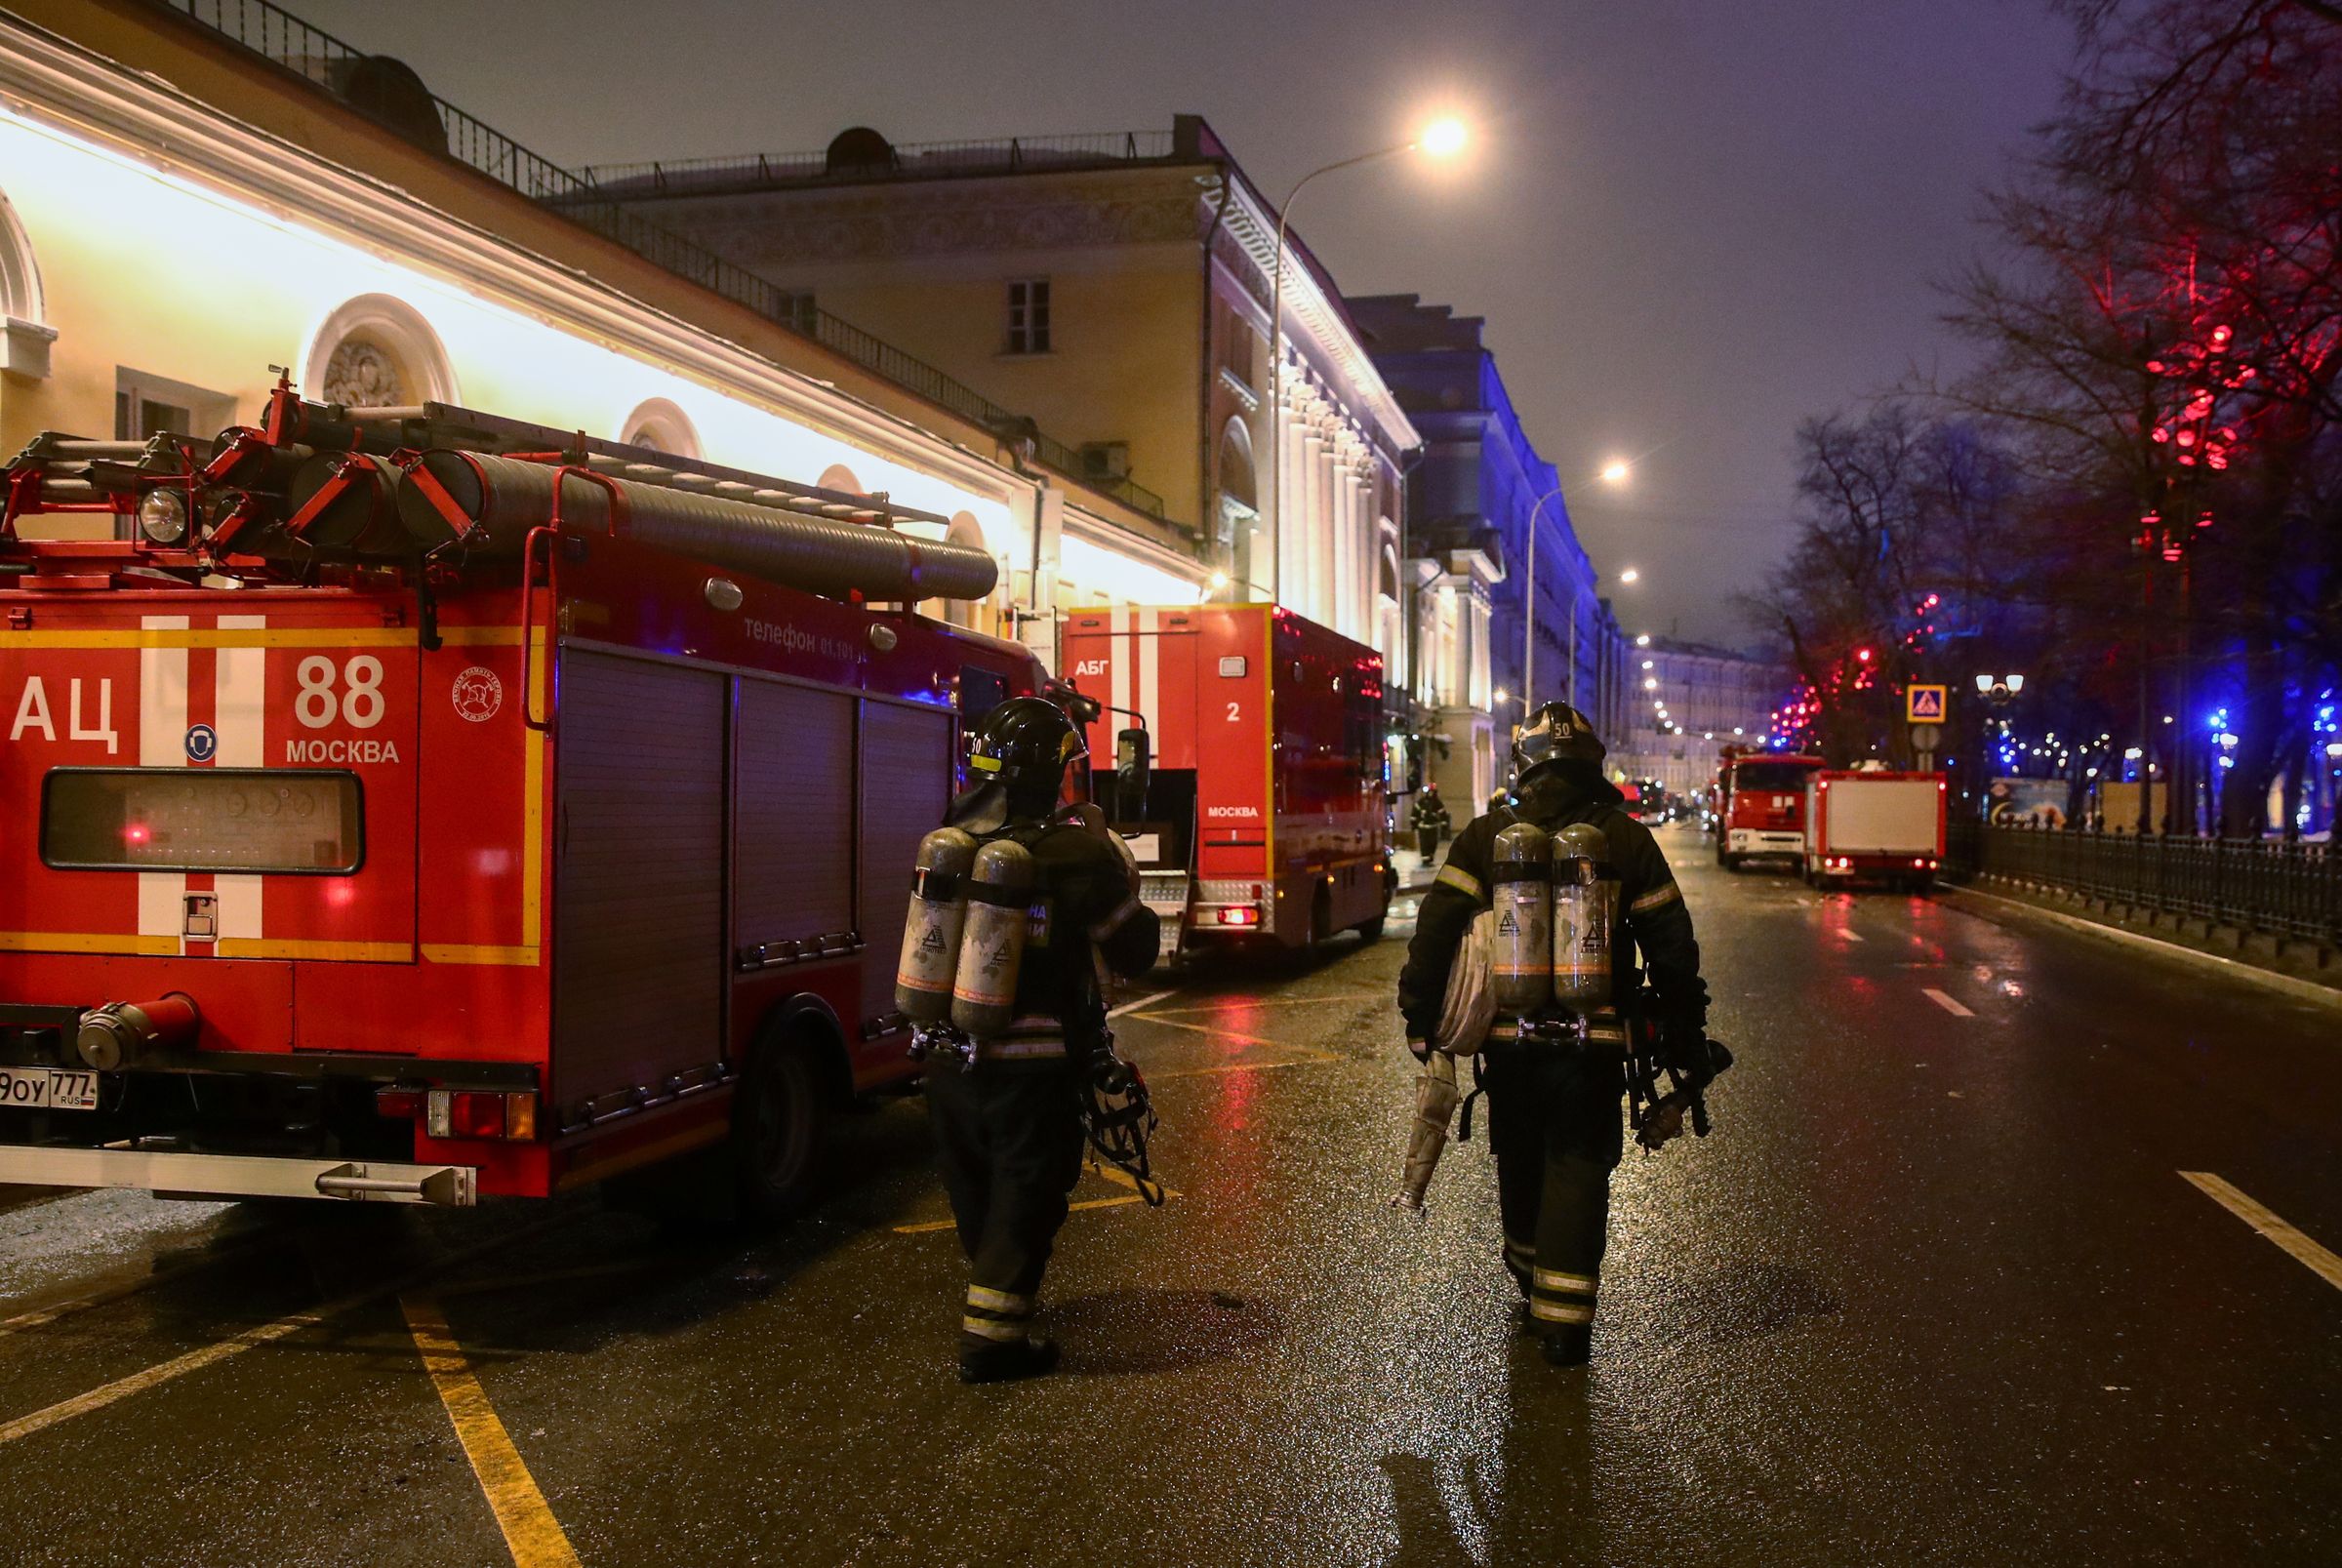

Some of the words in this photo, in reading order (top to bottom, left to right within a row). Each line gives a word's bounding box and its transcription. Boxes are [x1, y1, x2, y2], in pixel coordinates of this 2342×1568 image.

[1075, 660, 1109, 675] АБГ
[295, 655, 384, 729] 88
[10, 676, 118, 754] АЦ
[1227, 702, 1240, 721] 2
[1555, 722, 1570, 737] 50
[285, 740, 399, 763] МОСКВА
[1208, 807, 1258, 818] МОСКВА
[52, 1073, 91, 1096] 777
[61, 1096, 80, 1106] RUS
